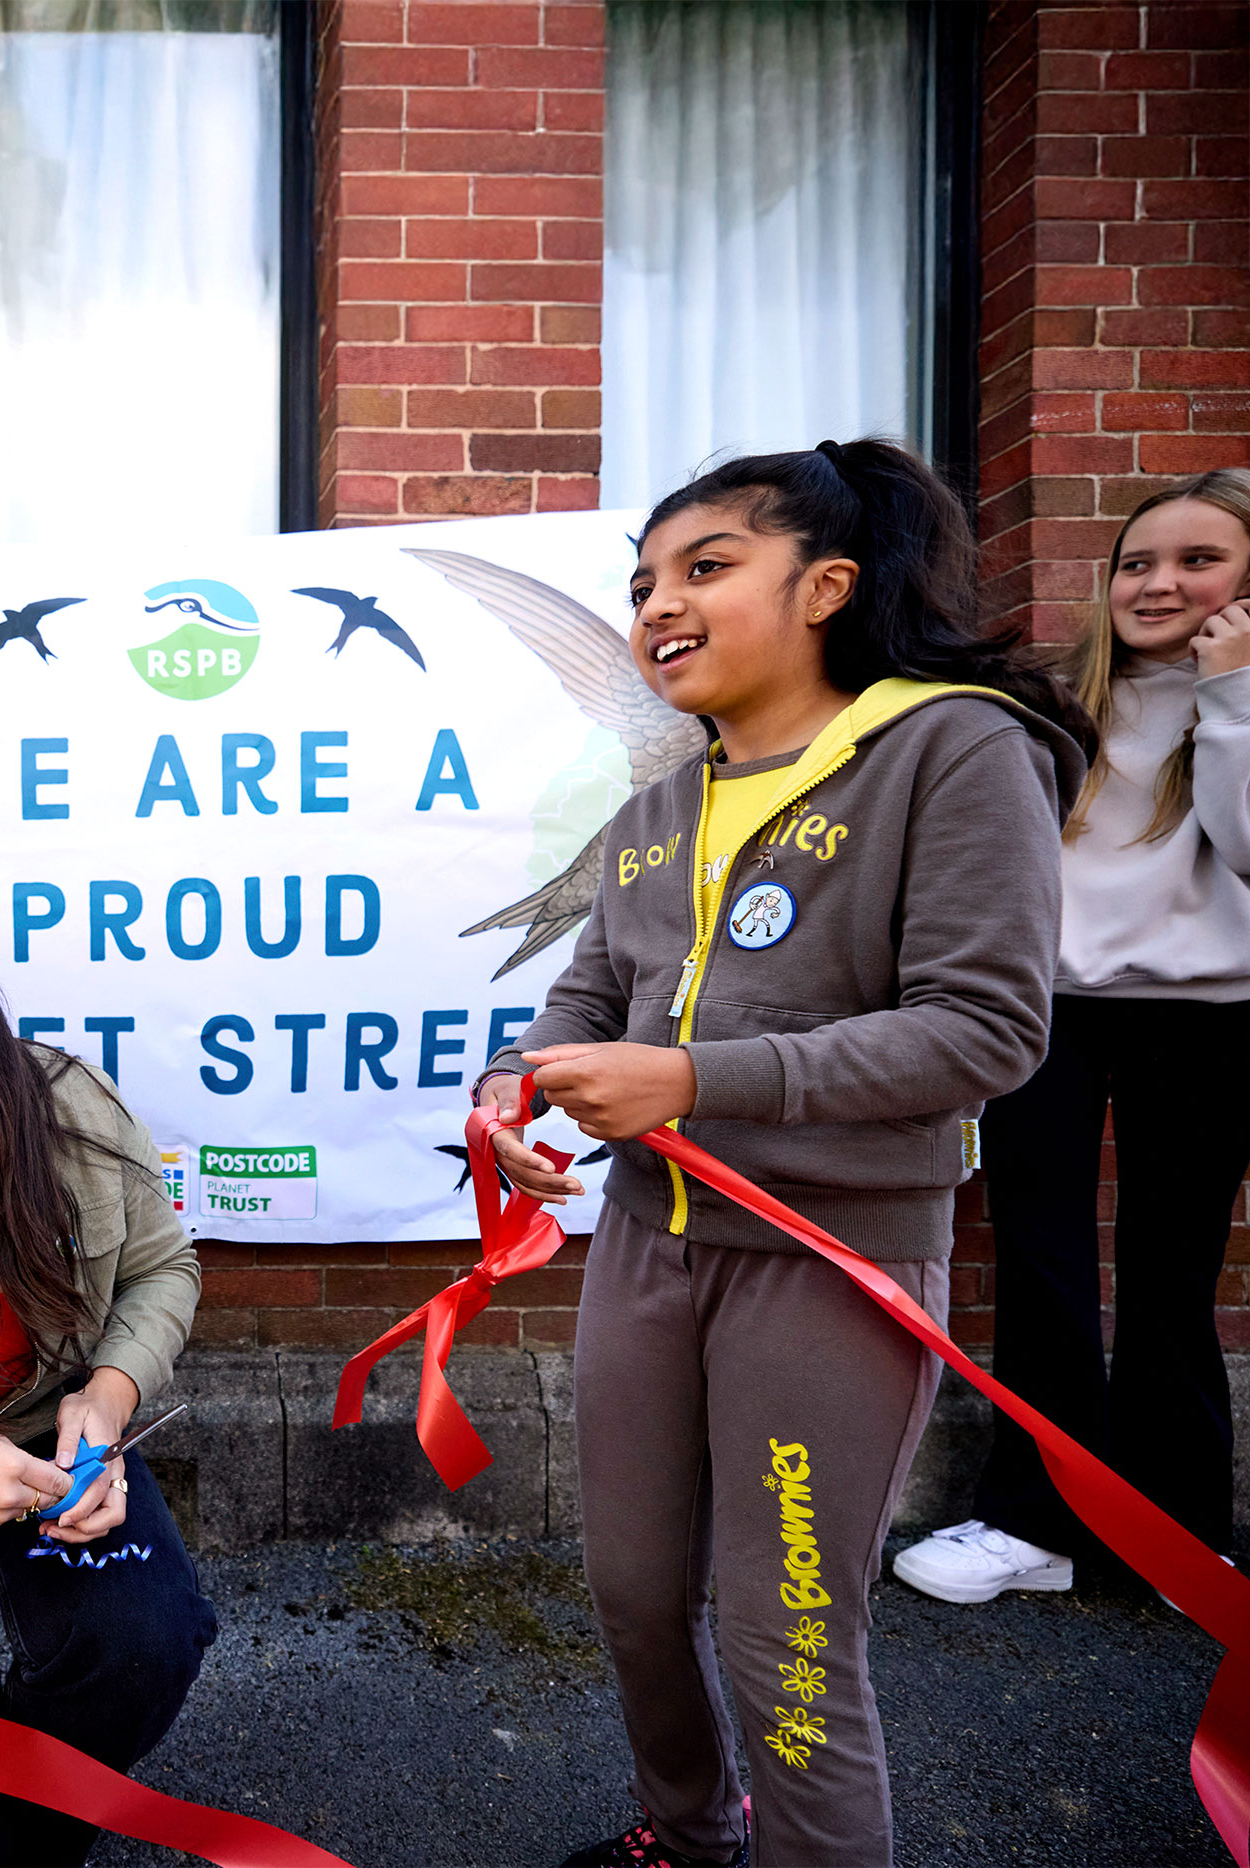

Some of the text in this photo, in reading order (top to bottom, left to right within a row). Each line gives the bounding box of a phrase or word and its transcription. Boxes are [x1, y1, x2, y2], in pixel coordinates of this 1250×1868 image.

[147, 648, 243, 678] RSPB
[135, 730, 350, 818] ARE
[414, 728, 480, 812] A
[12, 874, 381, 963] PROUD
[206, 1152, 310, 1173] POSTCODE
[207, 1181, 250, 1195] PLANET
[207, 1194, 271, 1212] TRUST
[762, 1437, 833, 1610] Brownies
